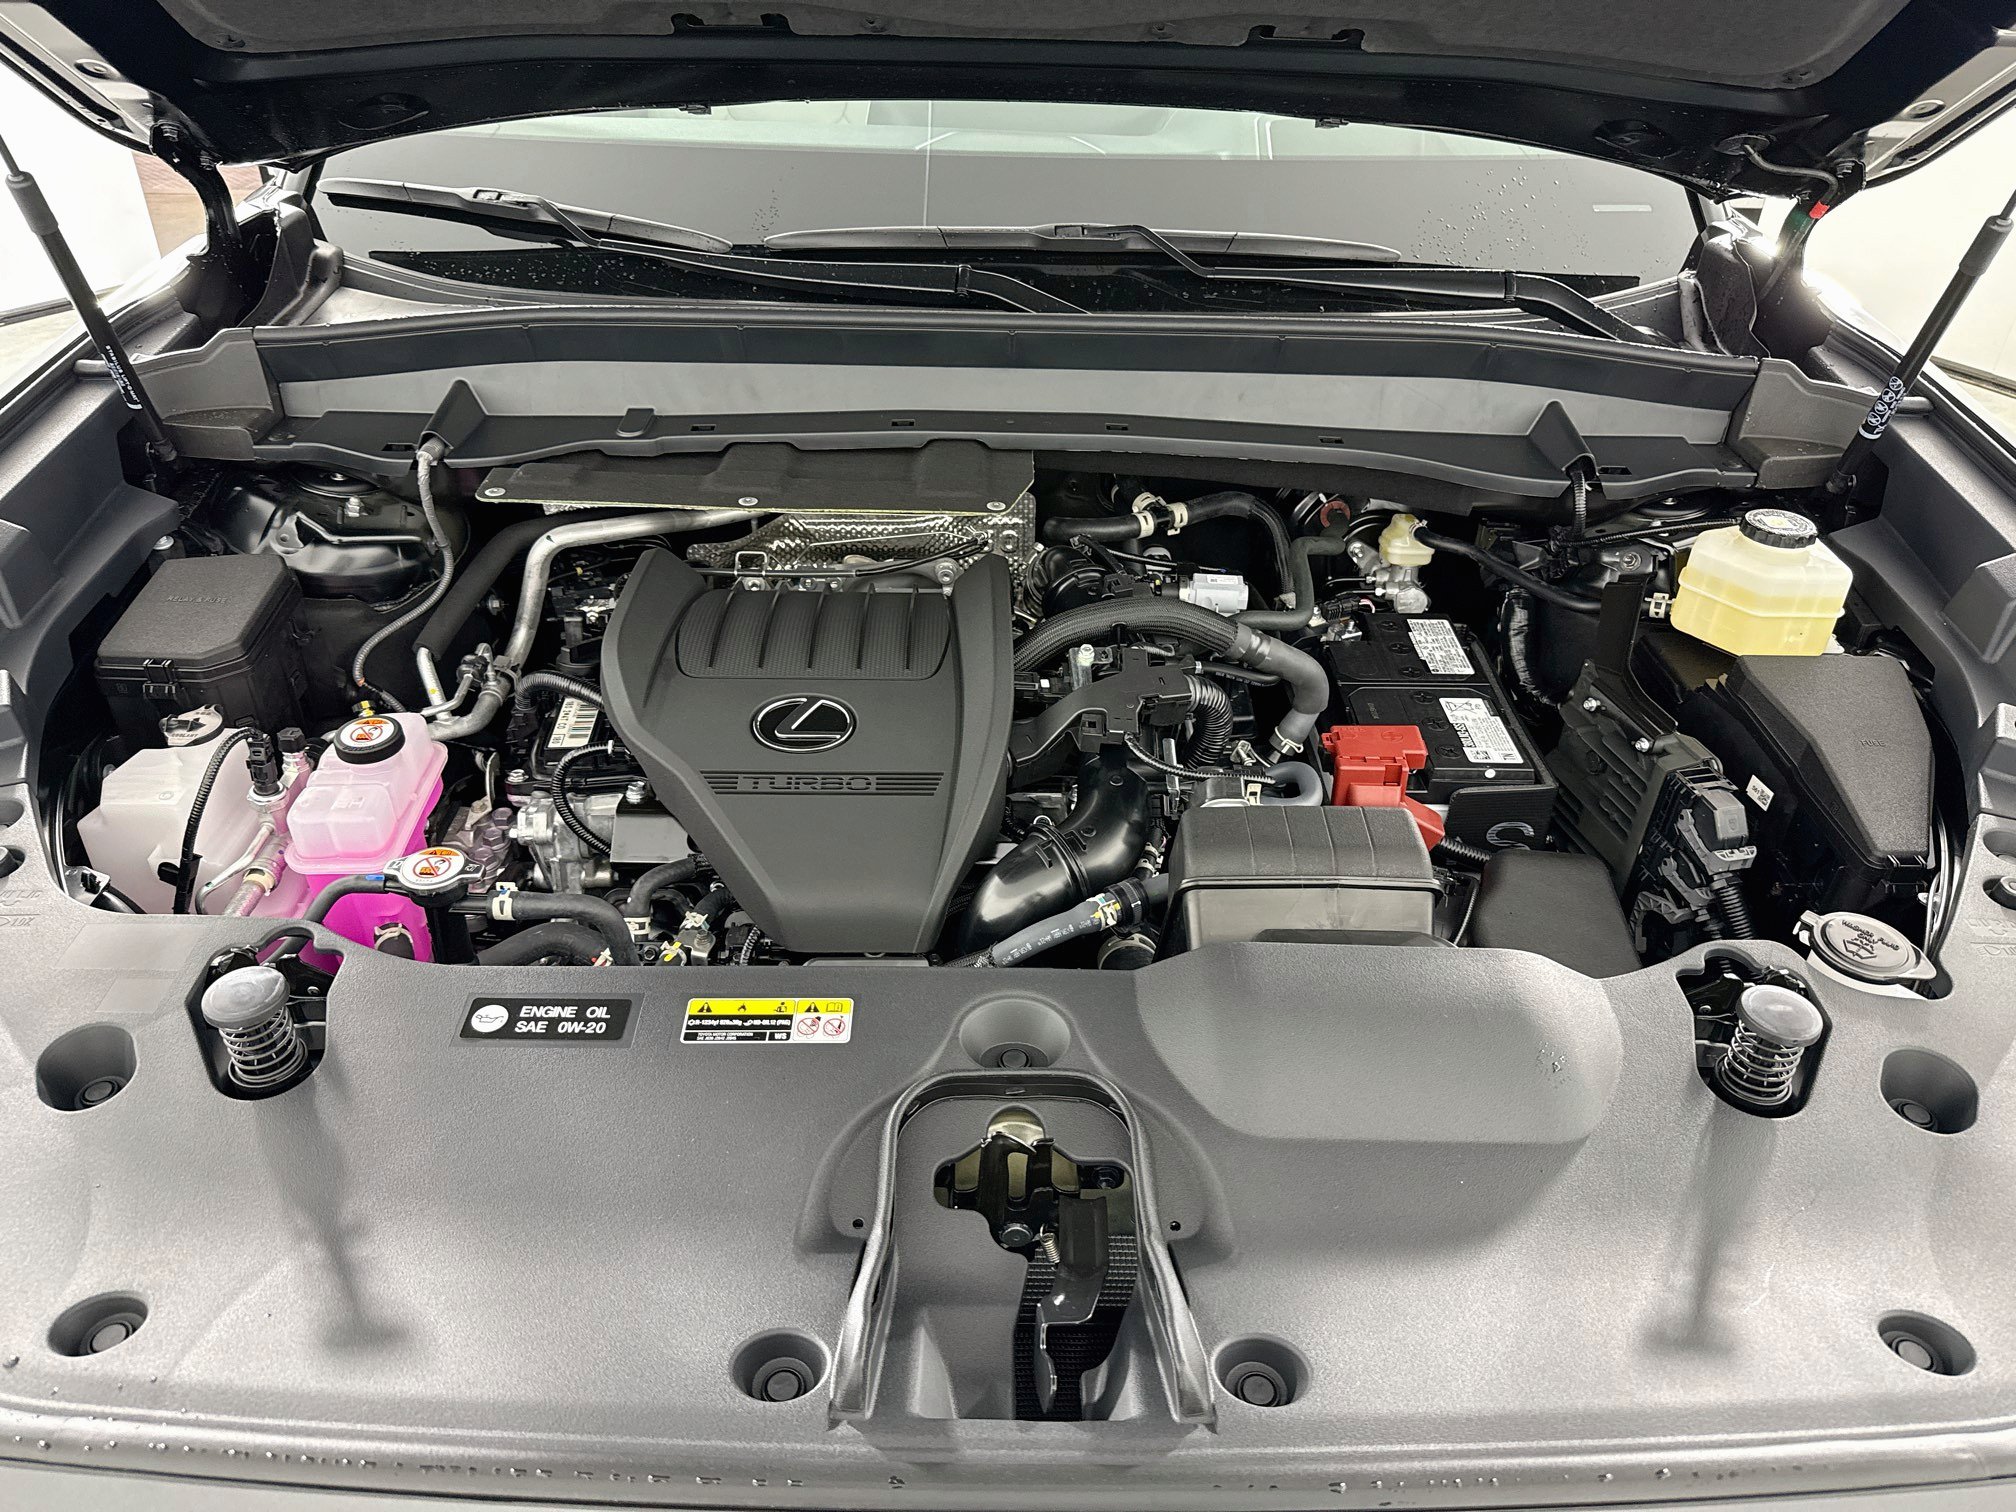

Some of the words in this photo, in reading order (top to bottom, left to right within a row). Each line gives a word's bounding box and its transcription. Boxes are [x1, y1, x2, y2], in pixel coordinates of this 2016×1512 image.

[105, 345, 124, 373] STABILUS
[743, 775, 874, 791] TURBO
[519, 1005, 578, 1019] ENGINE
[585, 1006, 611, 1019] OIL
[514, 1021, 549, 1033] SAE
[557, 1021, 607, 1034] 0W-20
